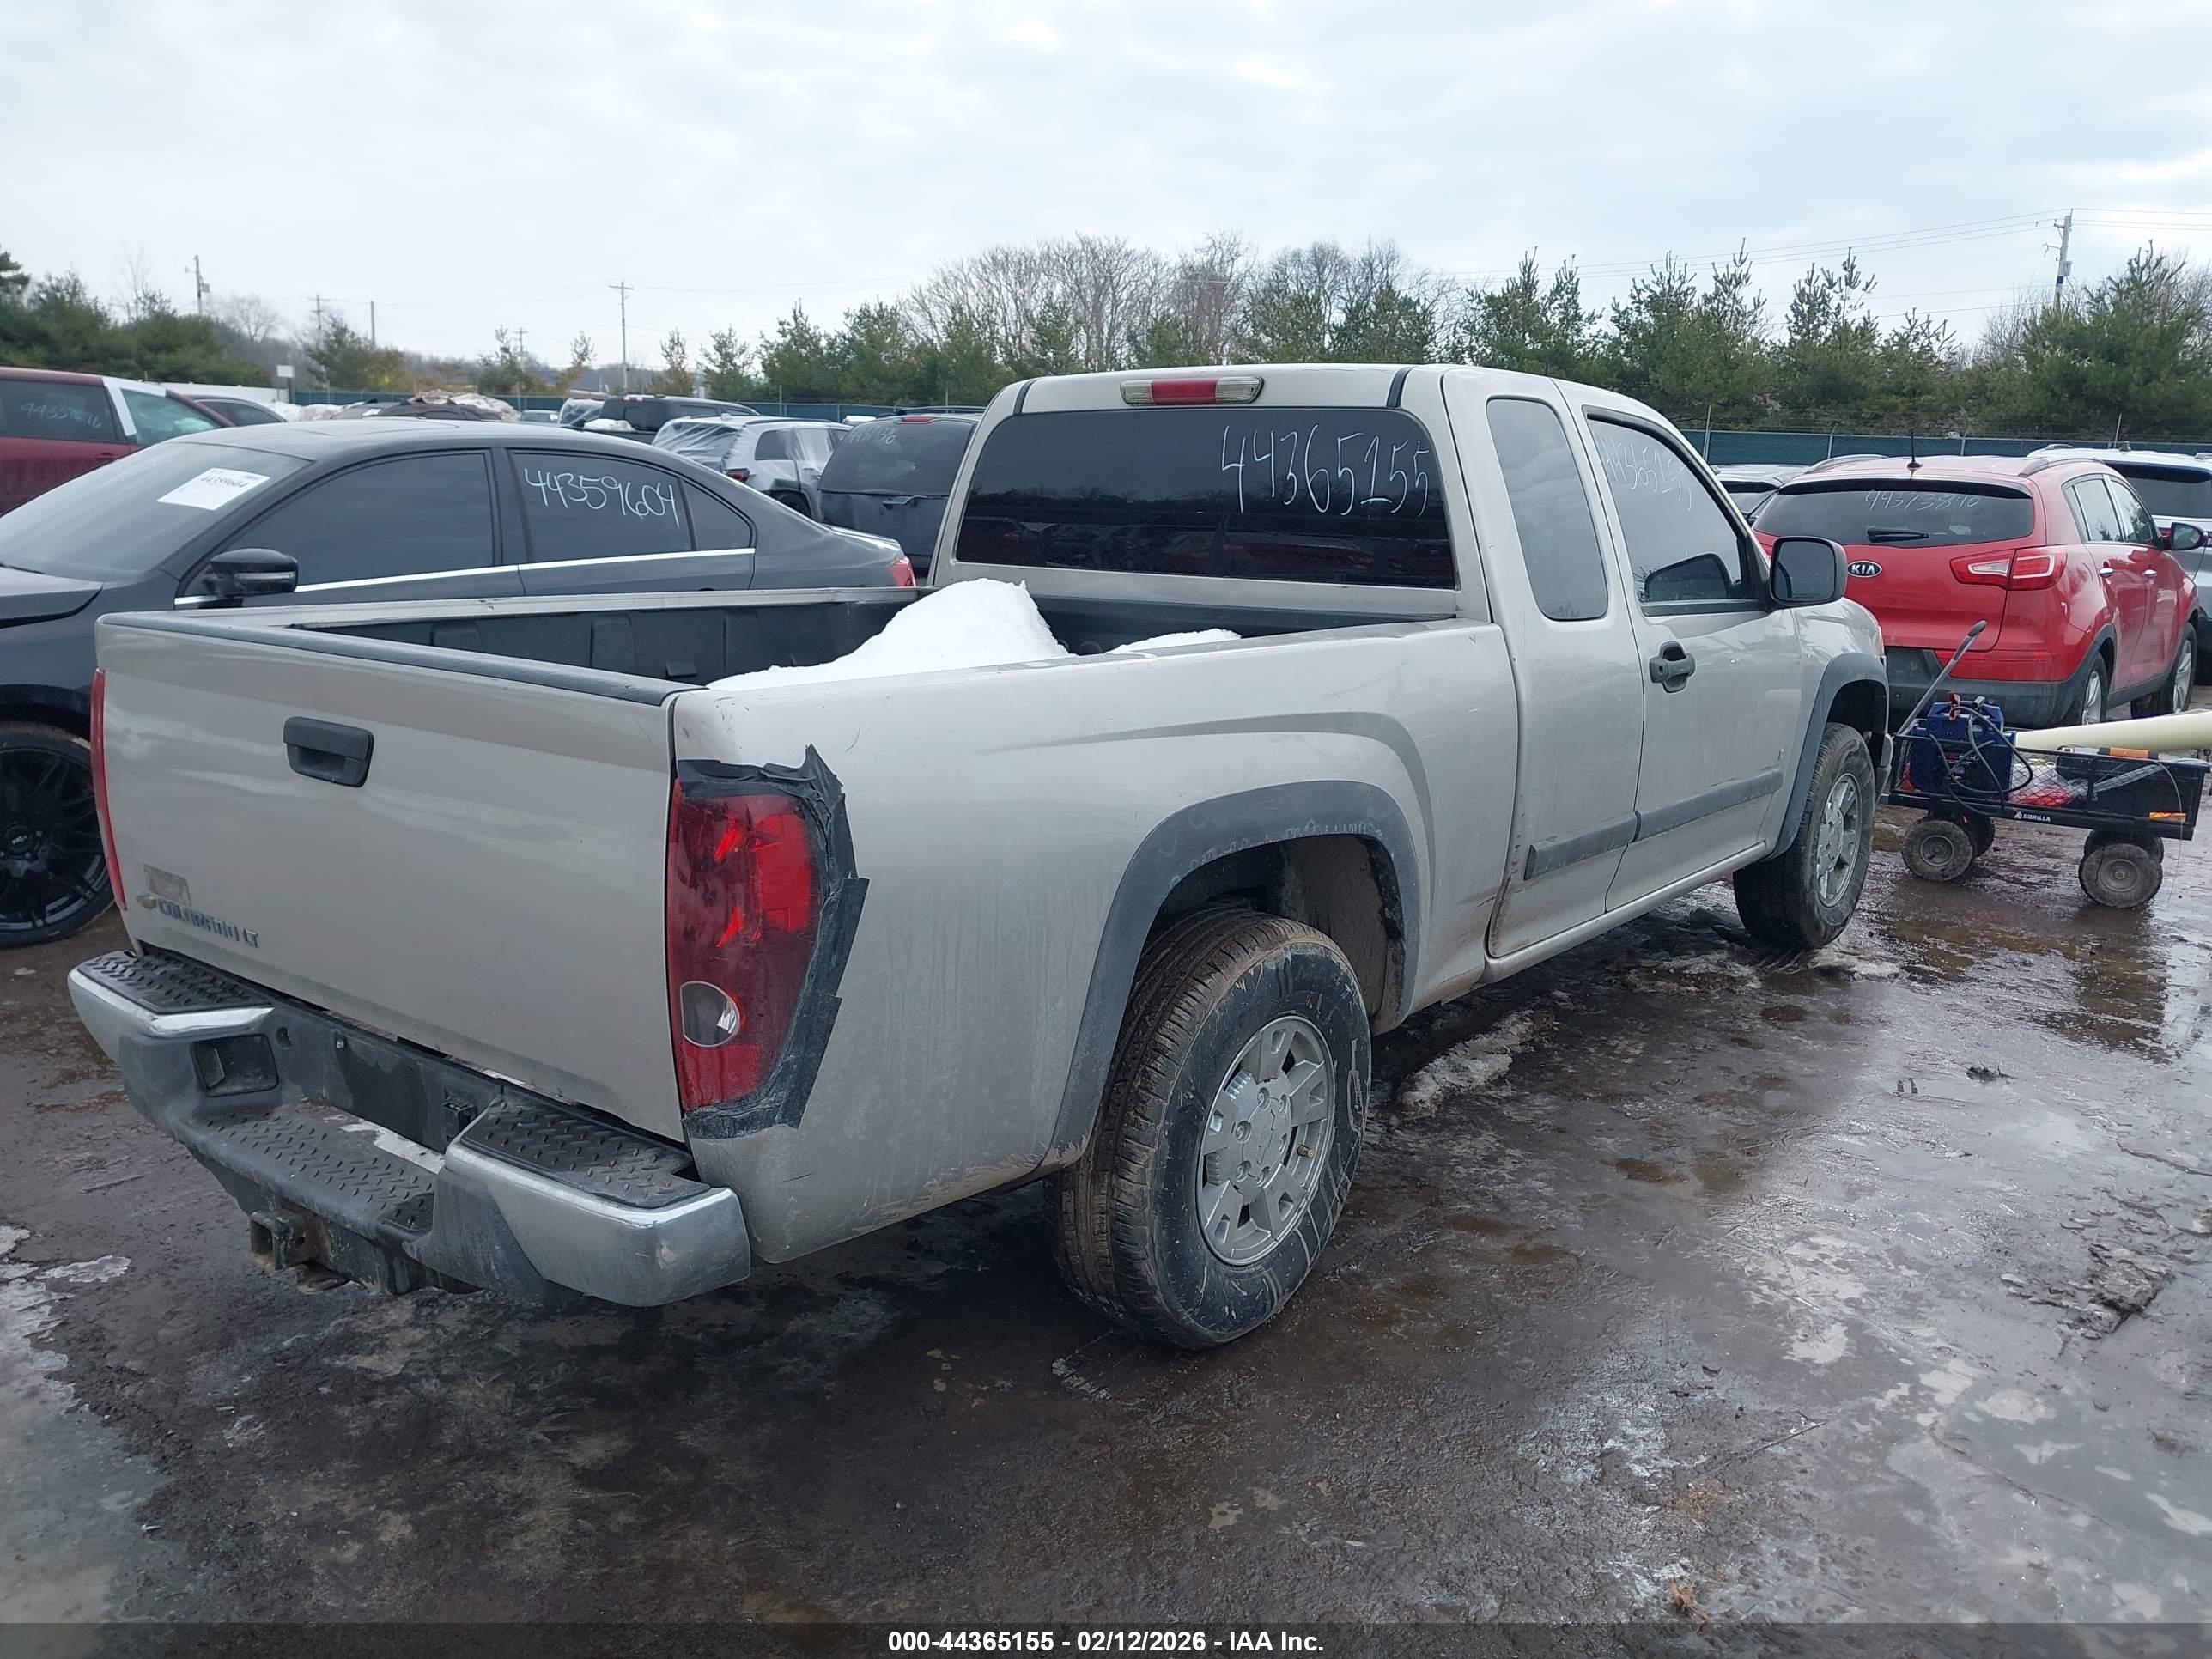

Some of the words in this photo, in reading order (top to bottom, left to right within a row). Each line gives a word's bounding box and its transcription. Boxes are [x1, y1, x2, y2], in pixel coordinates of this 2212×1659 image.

[1221, 424, 1430, 517] 44365155
[524, 468, 680, 528] 44359604
[1865, 489, 1982, 512] 44373840
[1851, 564, 1876, 575] KIA
[241, 927, 259, 949] LT
